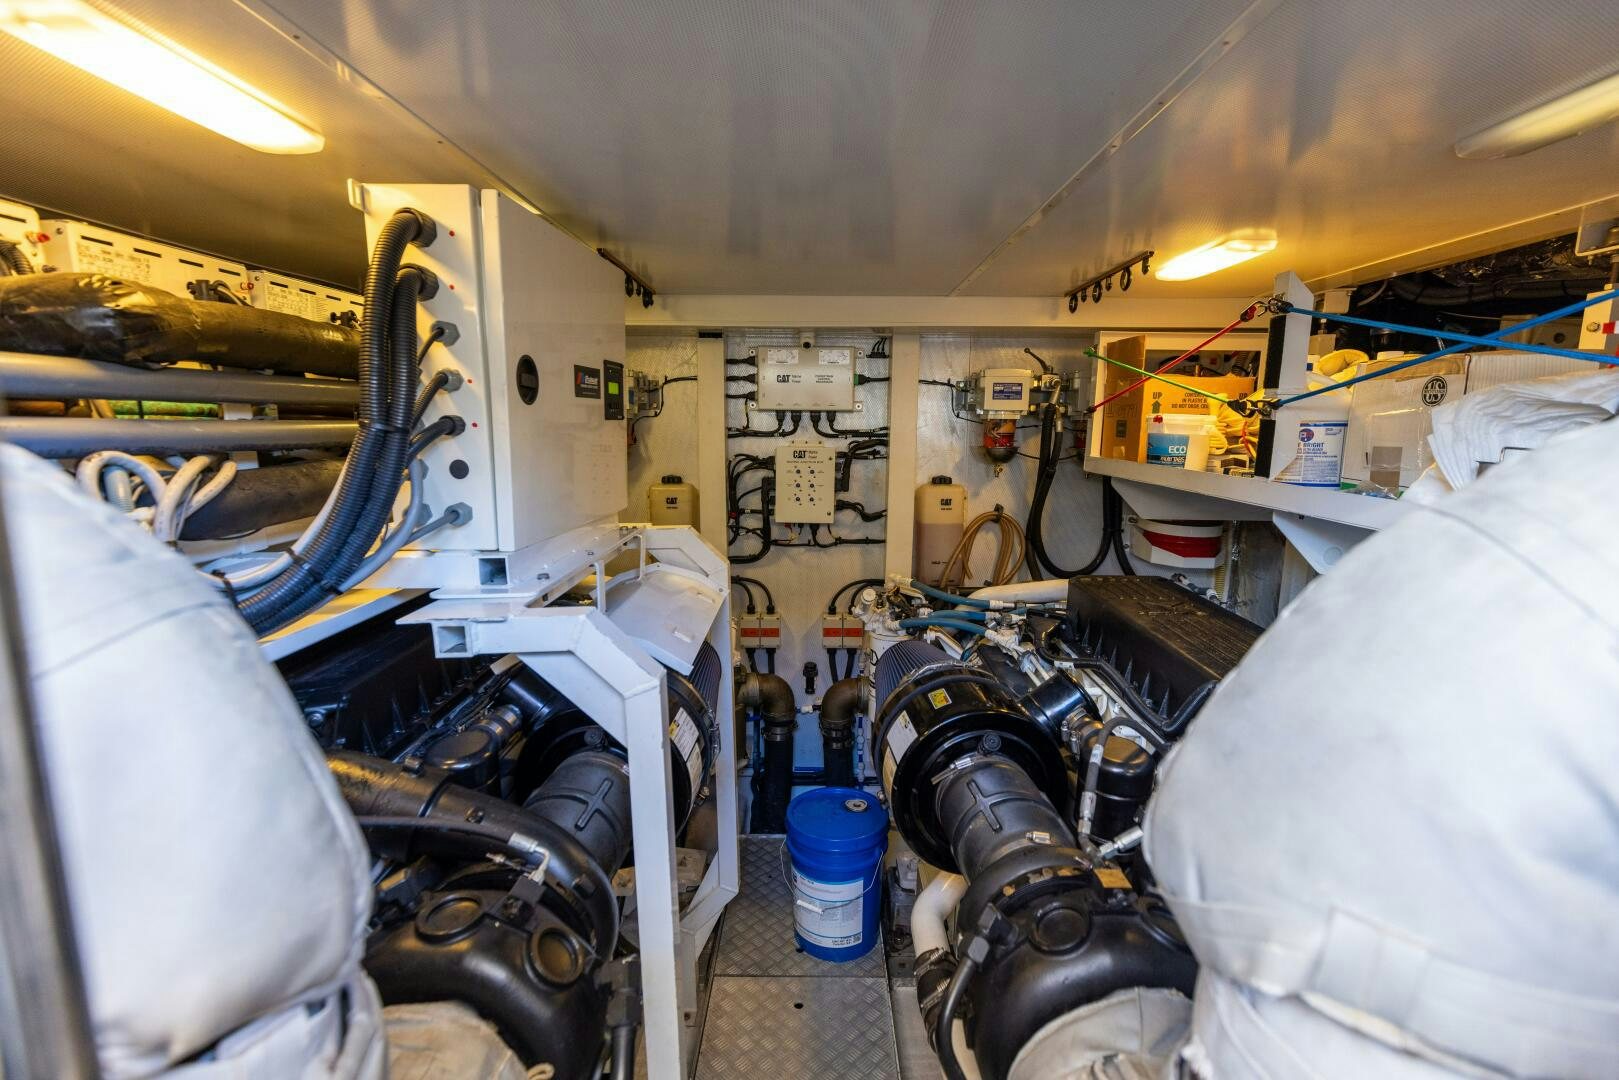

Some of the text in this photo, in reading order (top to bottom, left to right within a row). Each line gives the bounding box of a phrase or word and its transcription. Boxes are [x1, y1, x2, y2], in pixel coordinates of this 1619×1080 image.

[776, 374, 791, 383] CAT
[1152, 391, 1163, 400] UP
[1168, 445, 1187, 454] ECO
[793, 450, 806, 459] CAT
[940, 498, 952, 506] CAT
